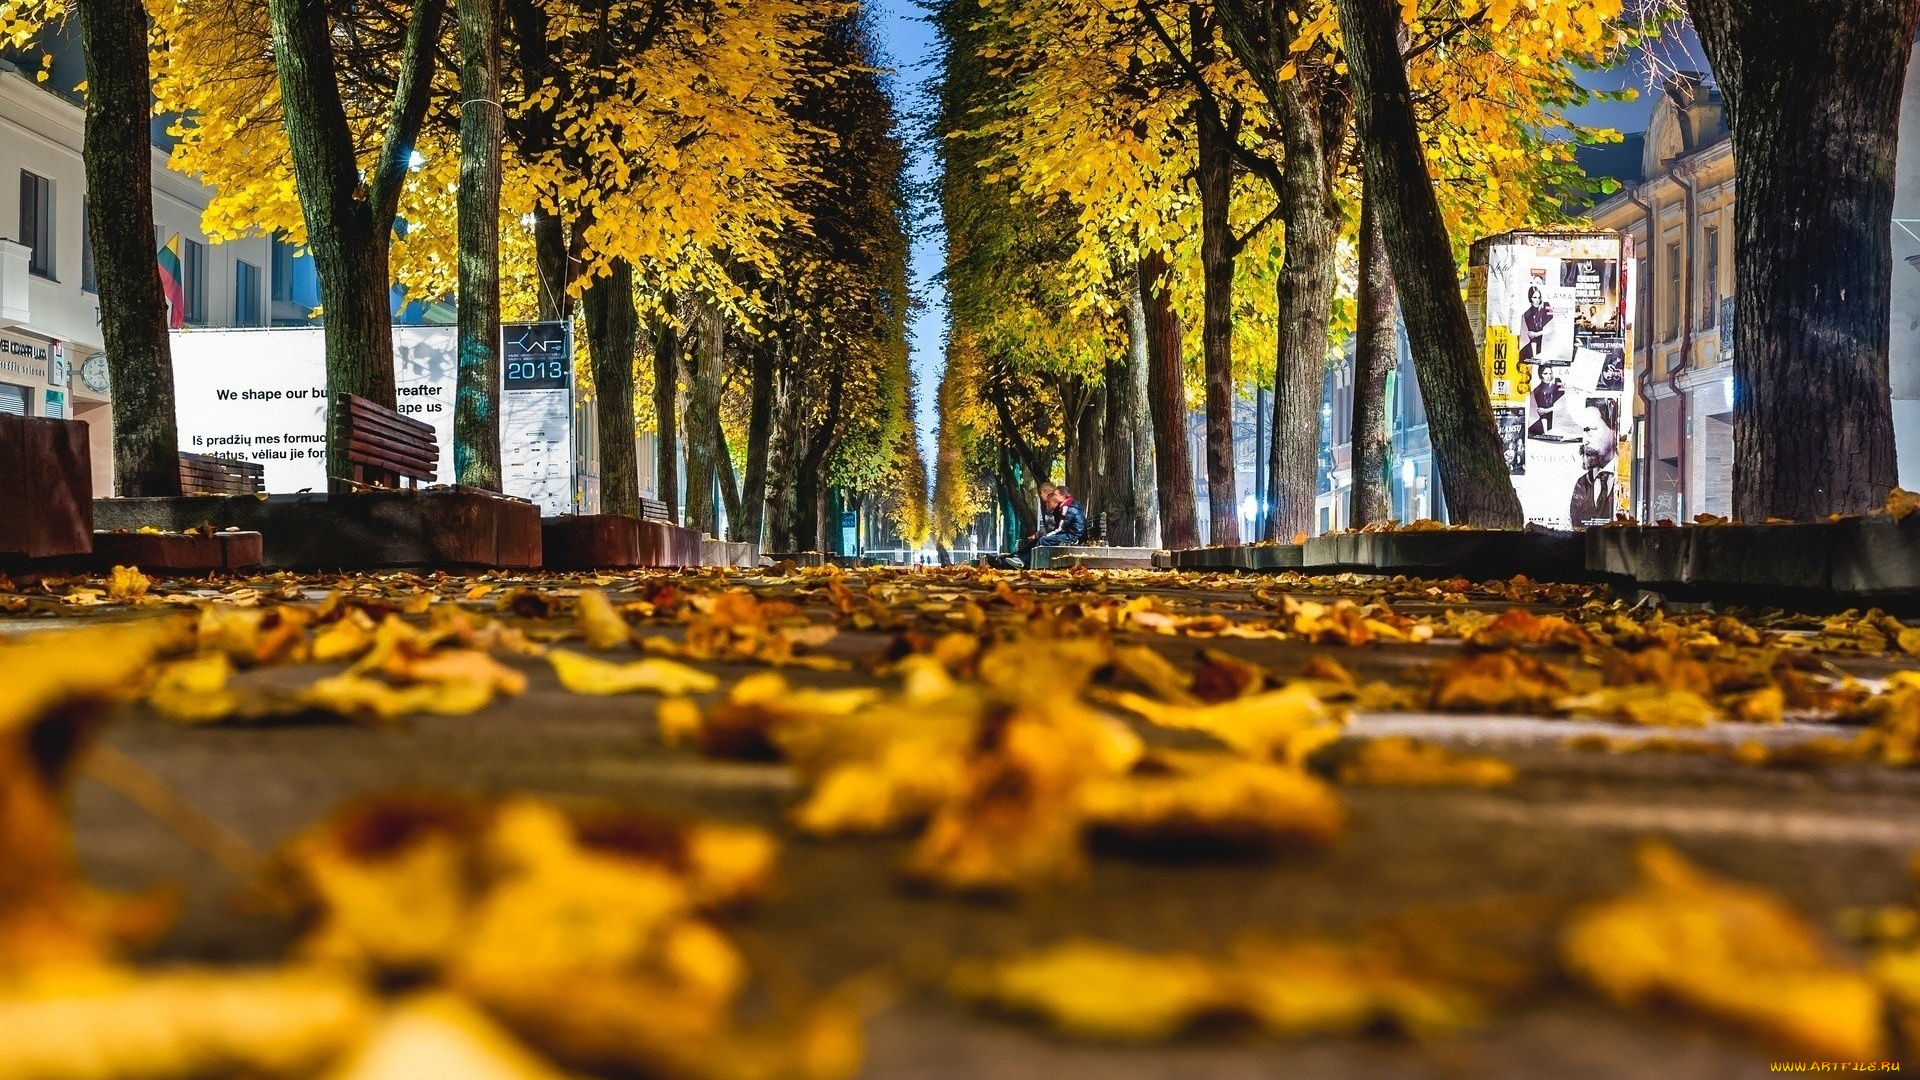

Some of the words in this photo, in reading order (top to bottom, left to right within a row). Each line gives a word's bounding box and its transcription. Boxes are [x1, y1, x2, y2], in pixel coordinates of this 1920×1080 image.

[509, 362, 561, 378] 2013
[1494, 360, 1506, 376] 99
[216, 389, 238, 400] We
[241, 388, 282, 401] shape
[285, 389, 309, 399] our
[395, 384, 442, 396] reafter
[398, 404, 422, 415] ape
[426, 403, 442, 412] us
[192, 435, 203, 446] Iš
[206, 434, 251, 447] pradžių
[254, 436, 280, 444] mes
[251, 448, 287, 460] vėliau
[290, 448, 304, 461] jie
[308, 447, 326, 458] for
